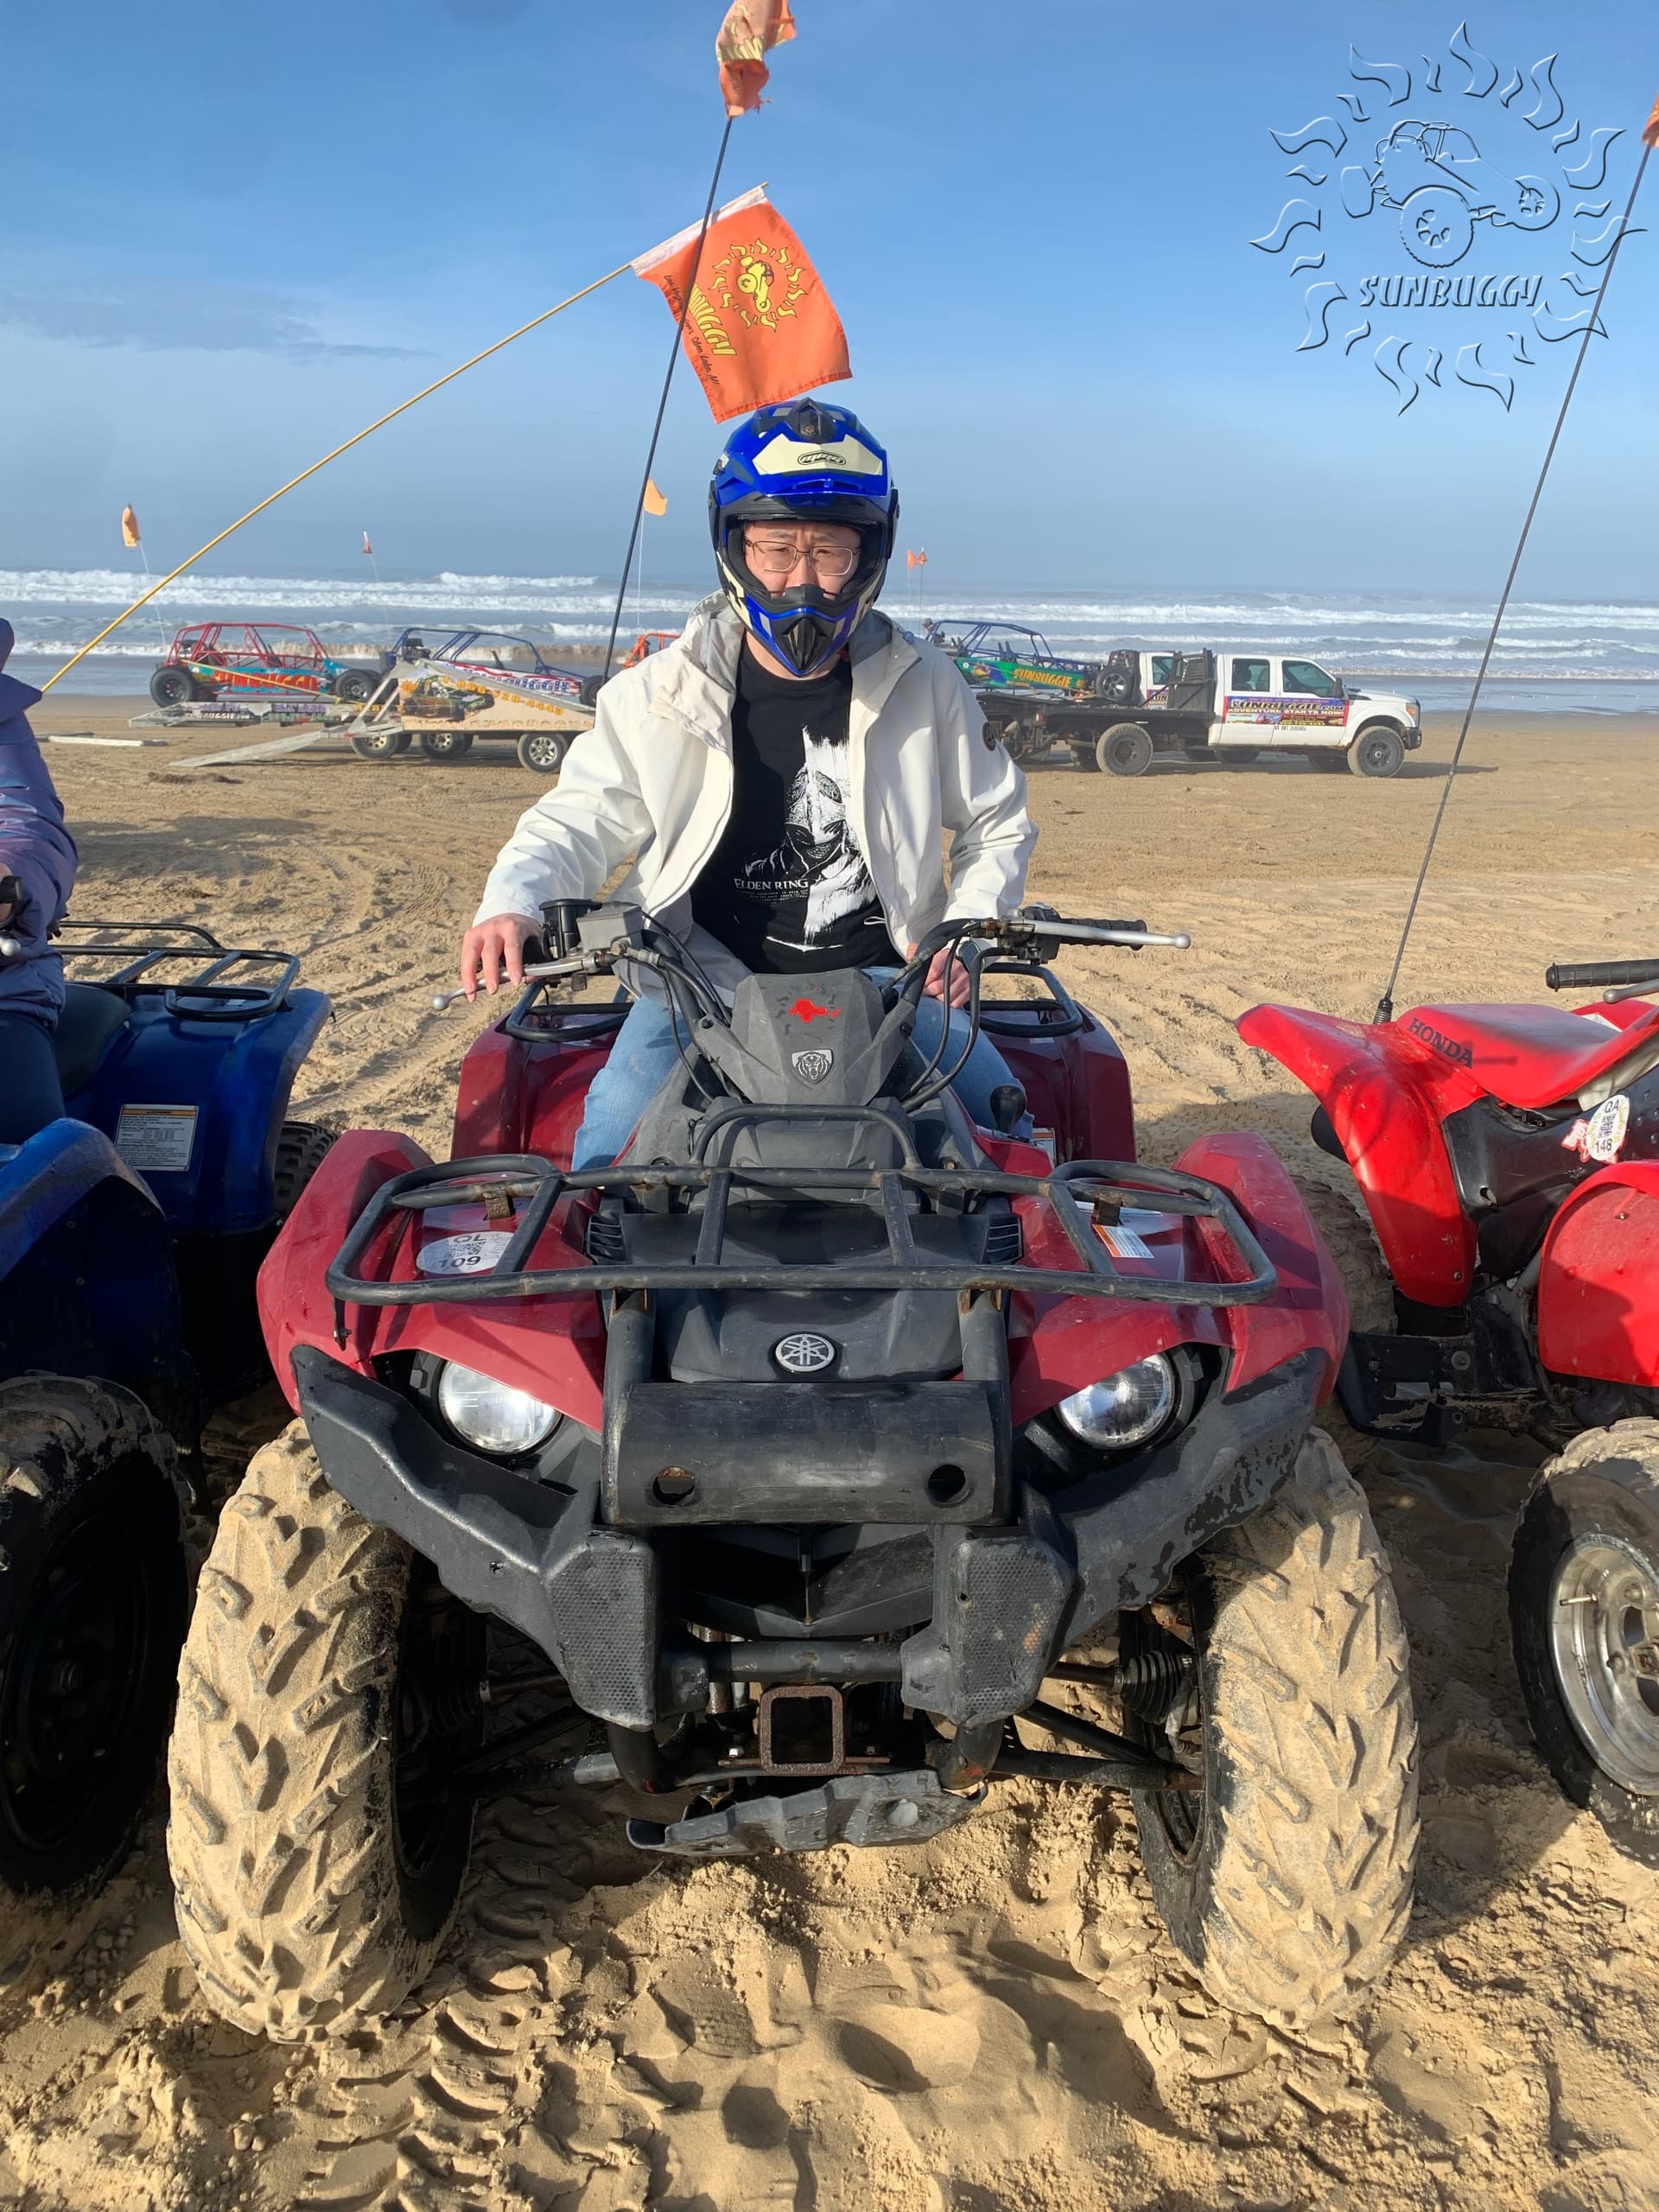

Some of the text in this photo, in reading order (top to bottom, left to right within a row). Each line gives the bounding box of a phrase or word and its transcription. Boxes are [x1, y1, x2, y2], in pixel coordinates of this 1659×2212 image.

[734, 878, 810, 890] ELDEN RING
[1407, 1017, 1473, 1069] HONDA
[1604, 1098, 1620, 1114] QA
[1595, 1138, 1612, 1154] 148
[438, 1255, 481, 1268] 109
